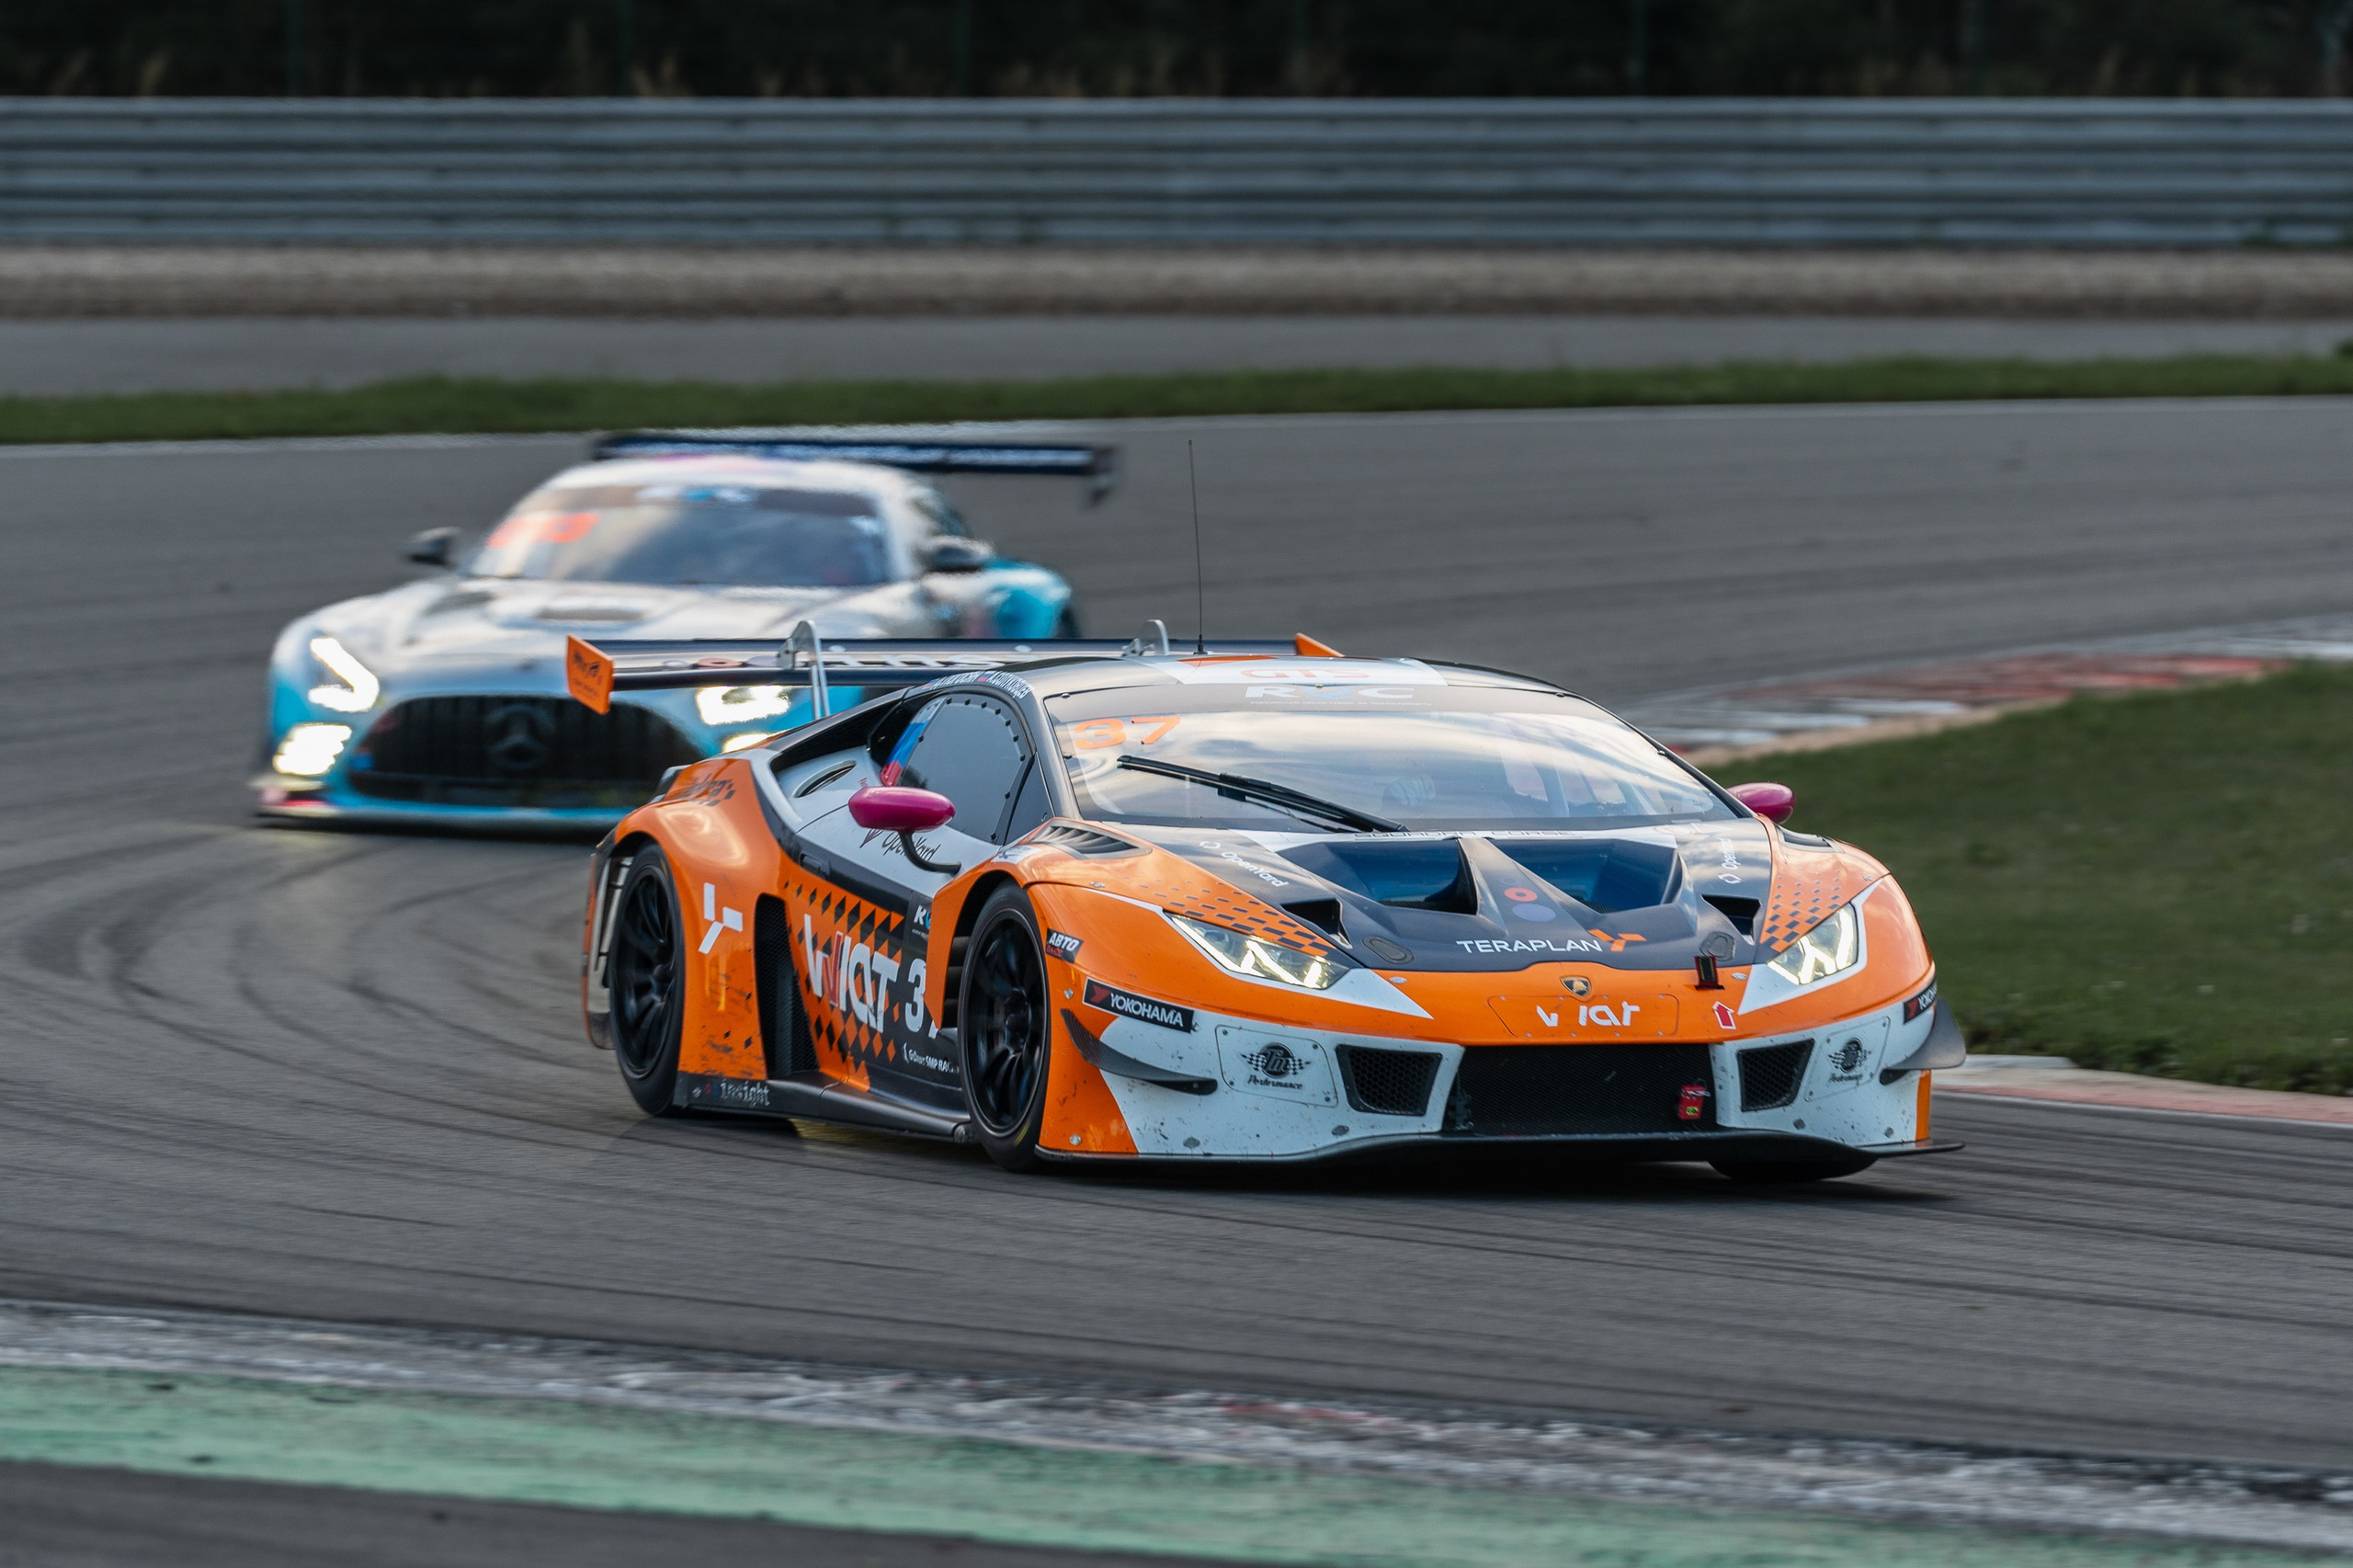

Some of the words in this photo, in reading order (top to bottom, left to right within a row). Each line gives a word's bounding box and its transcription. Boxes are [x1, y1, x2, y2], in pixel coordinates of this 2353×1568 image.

[1074, 716, 1181, 750] 37
[1221, 851, 1290, 887] OpenYard
[1456, 939, 1603, 953] TERAPLAN
[1110, 993, 1184, 1028] YOKOHAMA
